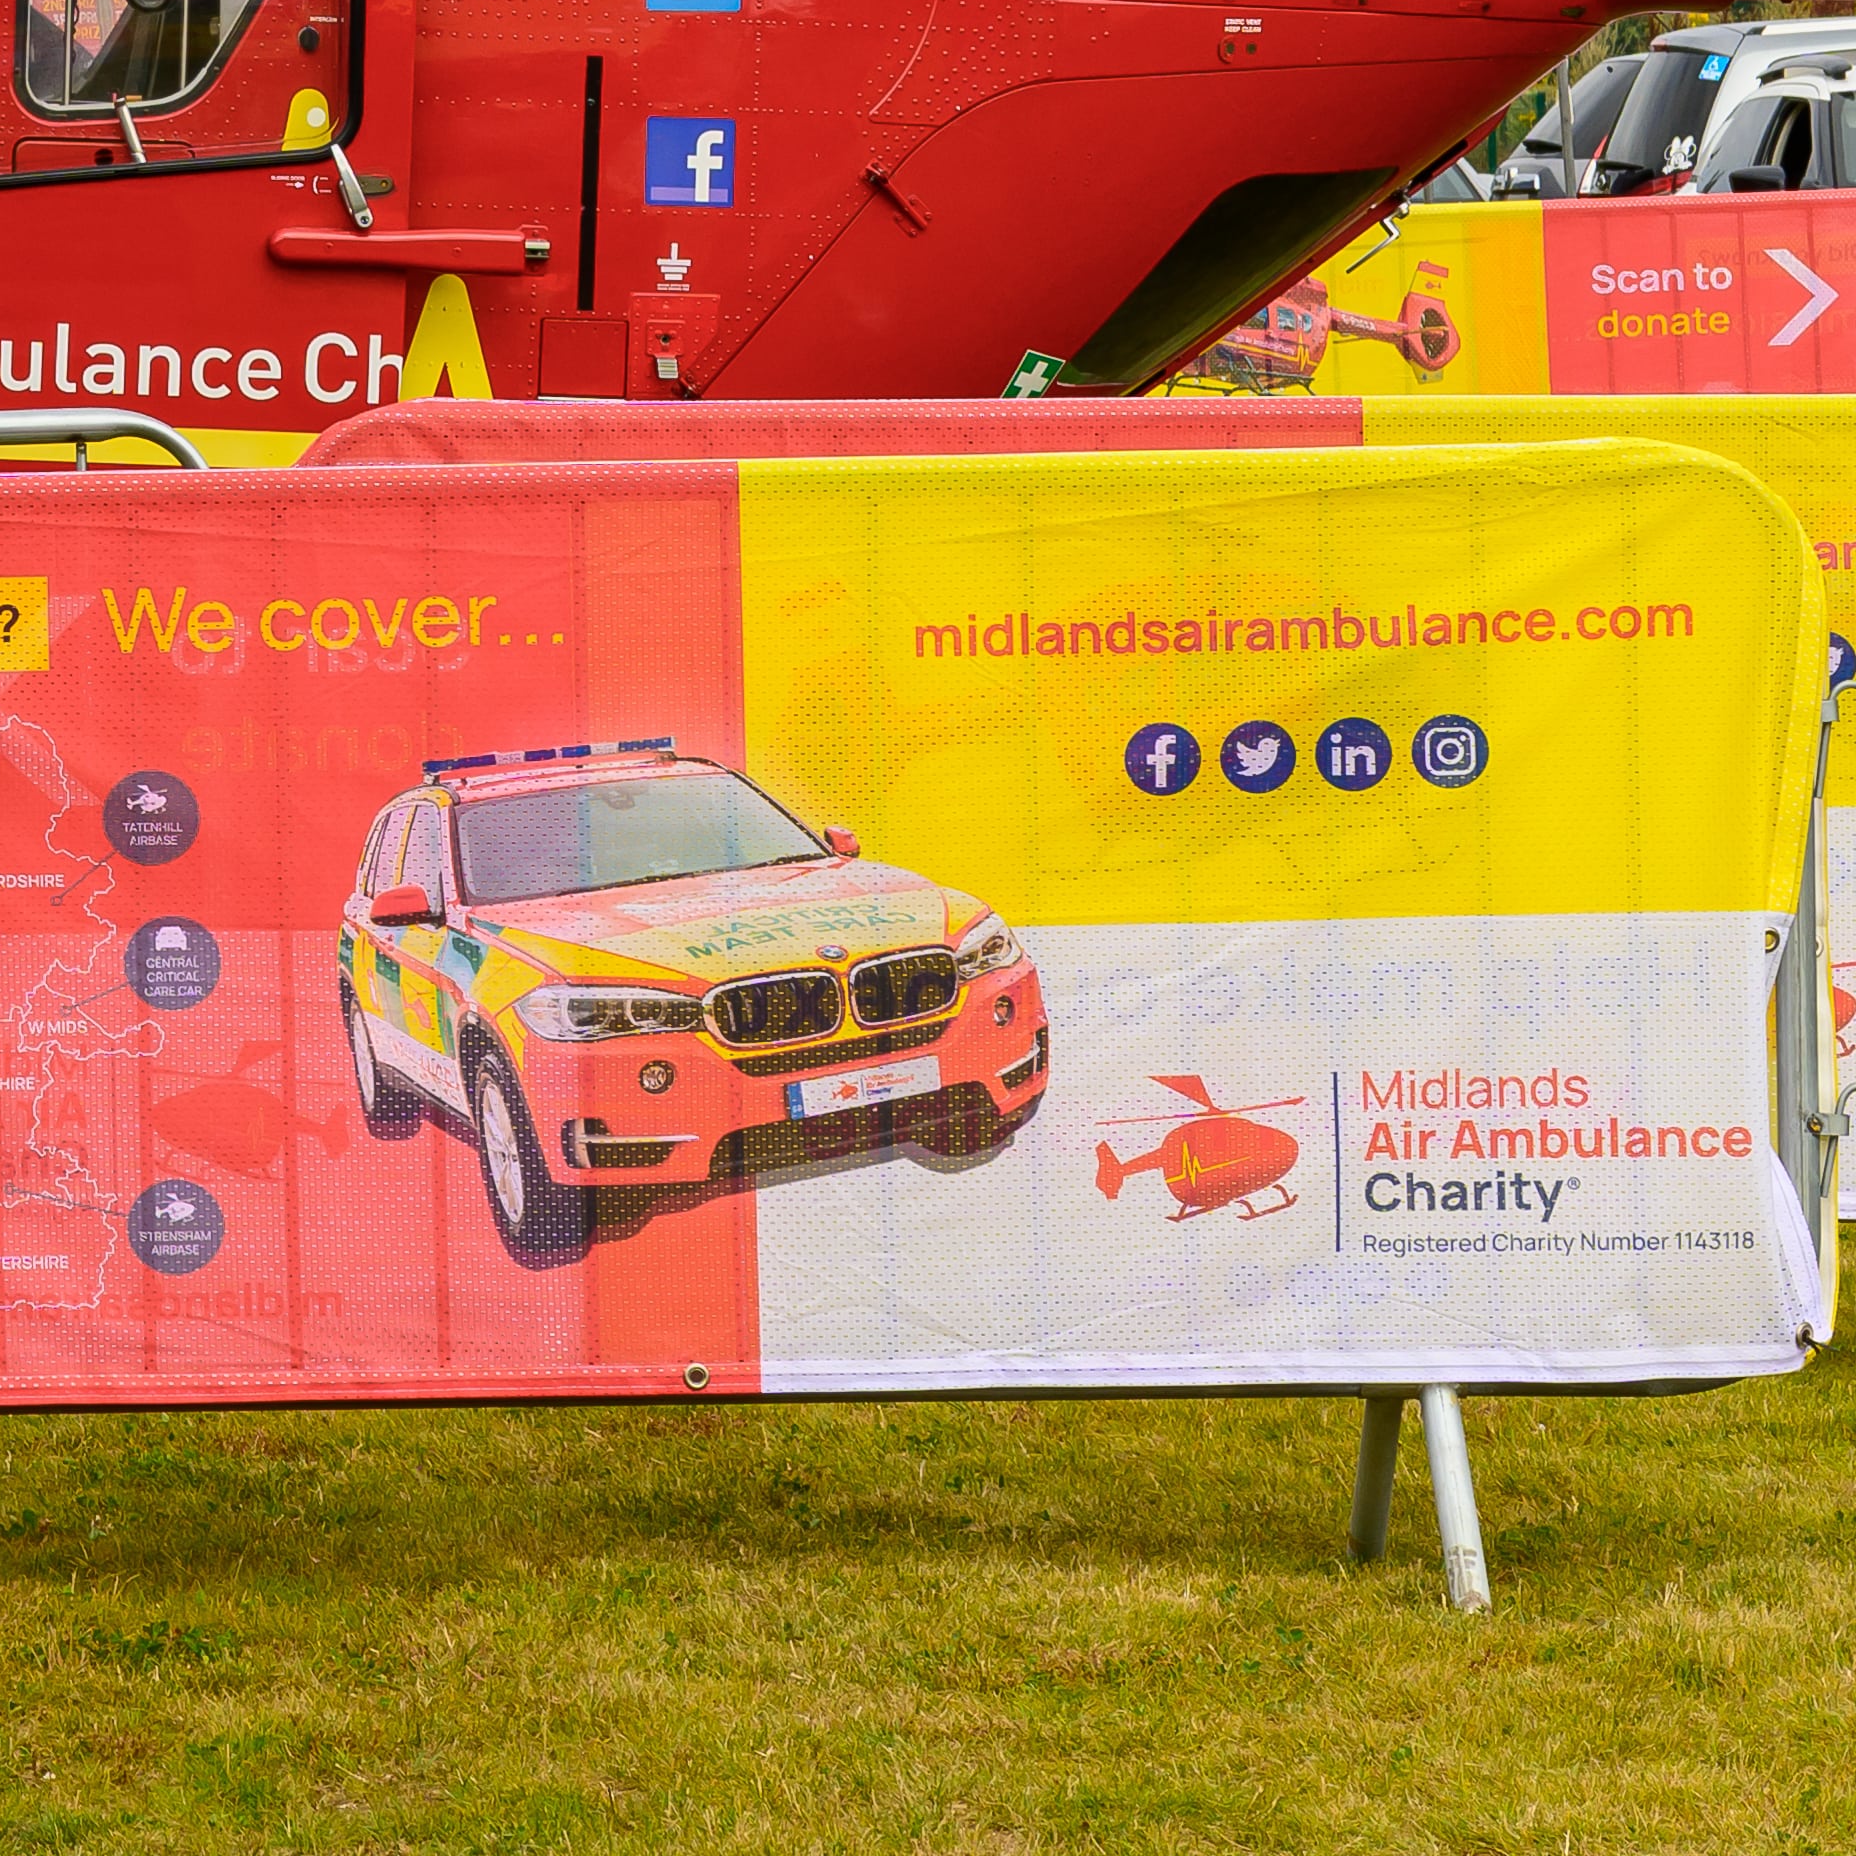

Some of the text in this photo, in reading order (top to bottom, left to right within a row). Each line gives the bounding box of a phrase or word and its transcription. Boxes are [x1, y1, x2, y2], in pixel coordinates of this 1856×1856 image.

[1591, 262, 1733, 295] Scan to
[1598, 307, 1731, 338] donate
[100, 585, 236, 654] We
[913, 600, 1695, 658] midlandsairambulance.com
[122, 821, 184, 834] TATENHILL
[129, 835, 179, 847] AIRBASE
[145, 957, 199, 970] CENTRAL
[146, 971, 200, 983] CRITICAL
[144, 985, 203, 997] CARE CAR
[26, 1019, 89, 1036] W MIDS
[1362, 1067, 1589, 1111] Midlands
[1364, 1117, 1752, 1161] Air Ambulance
[138, 1229, 213, 1243] STRENSHAM
[1362, 1230, 1755, 1258] Registered Charity Number 1143118
[150, 1243, 202, 1256] AIRBASE
